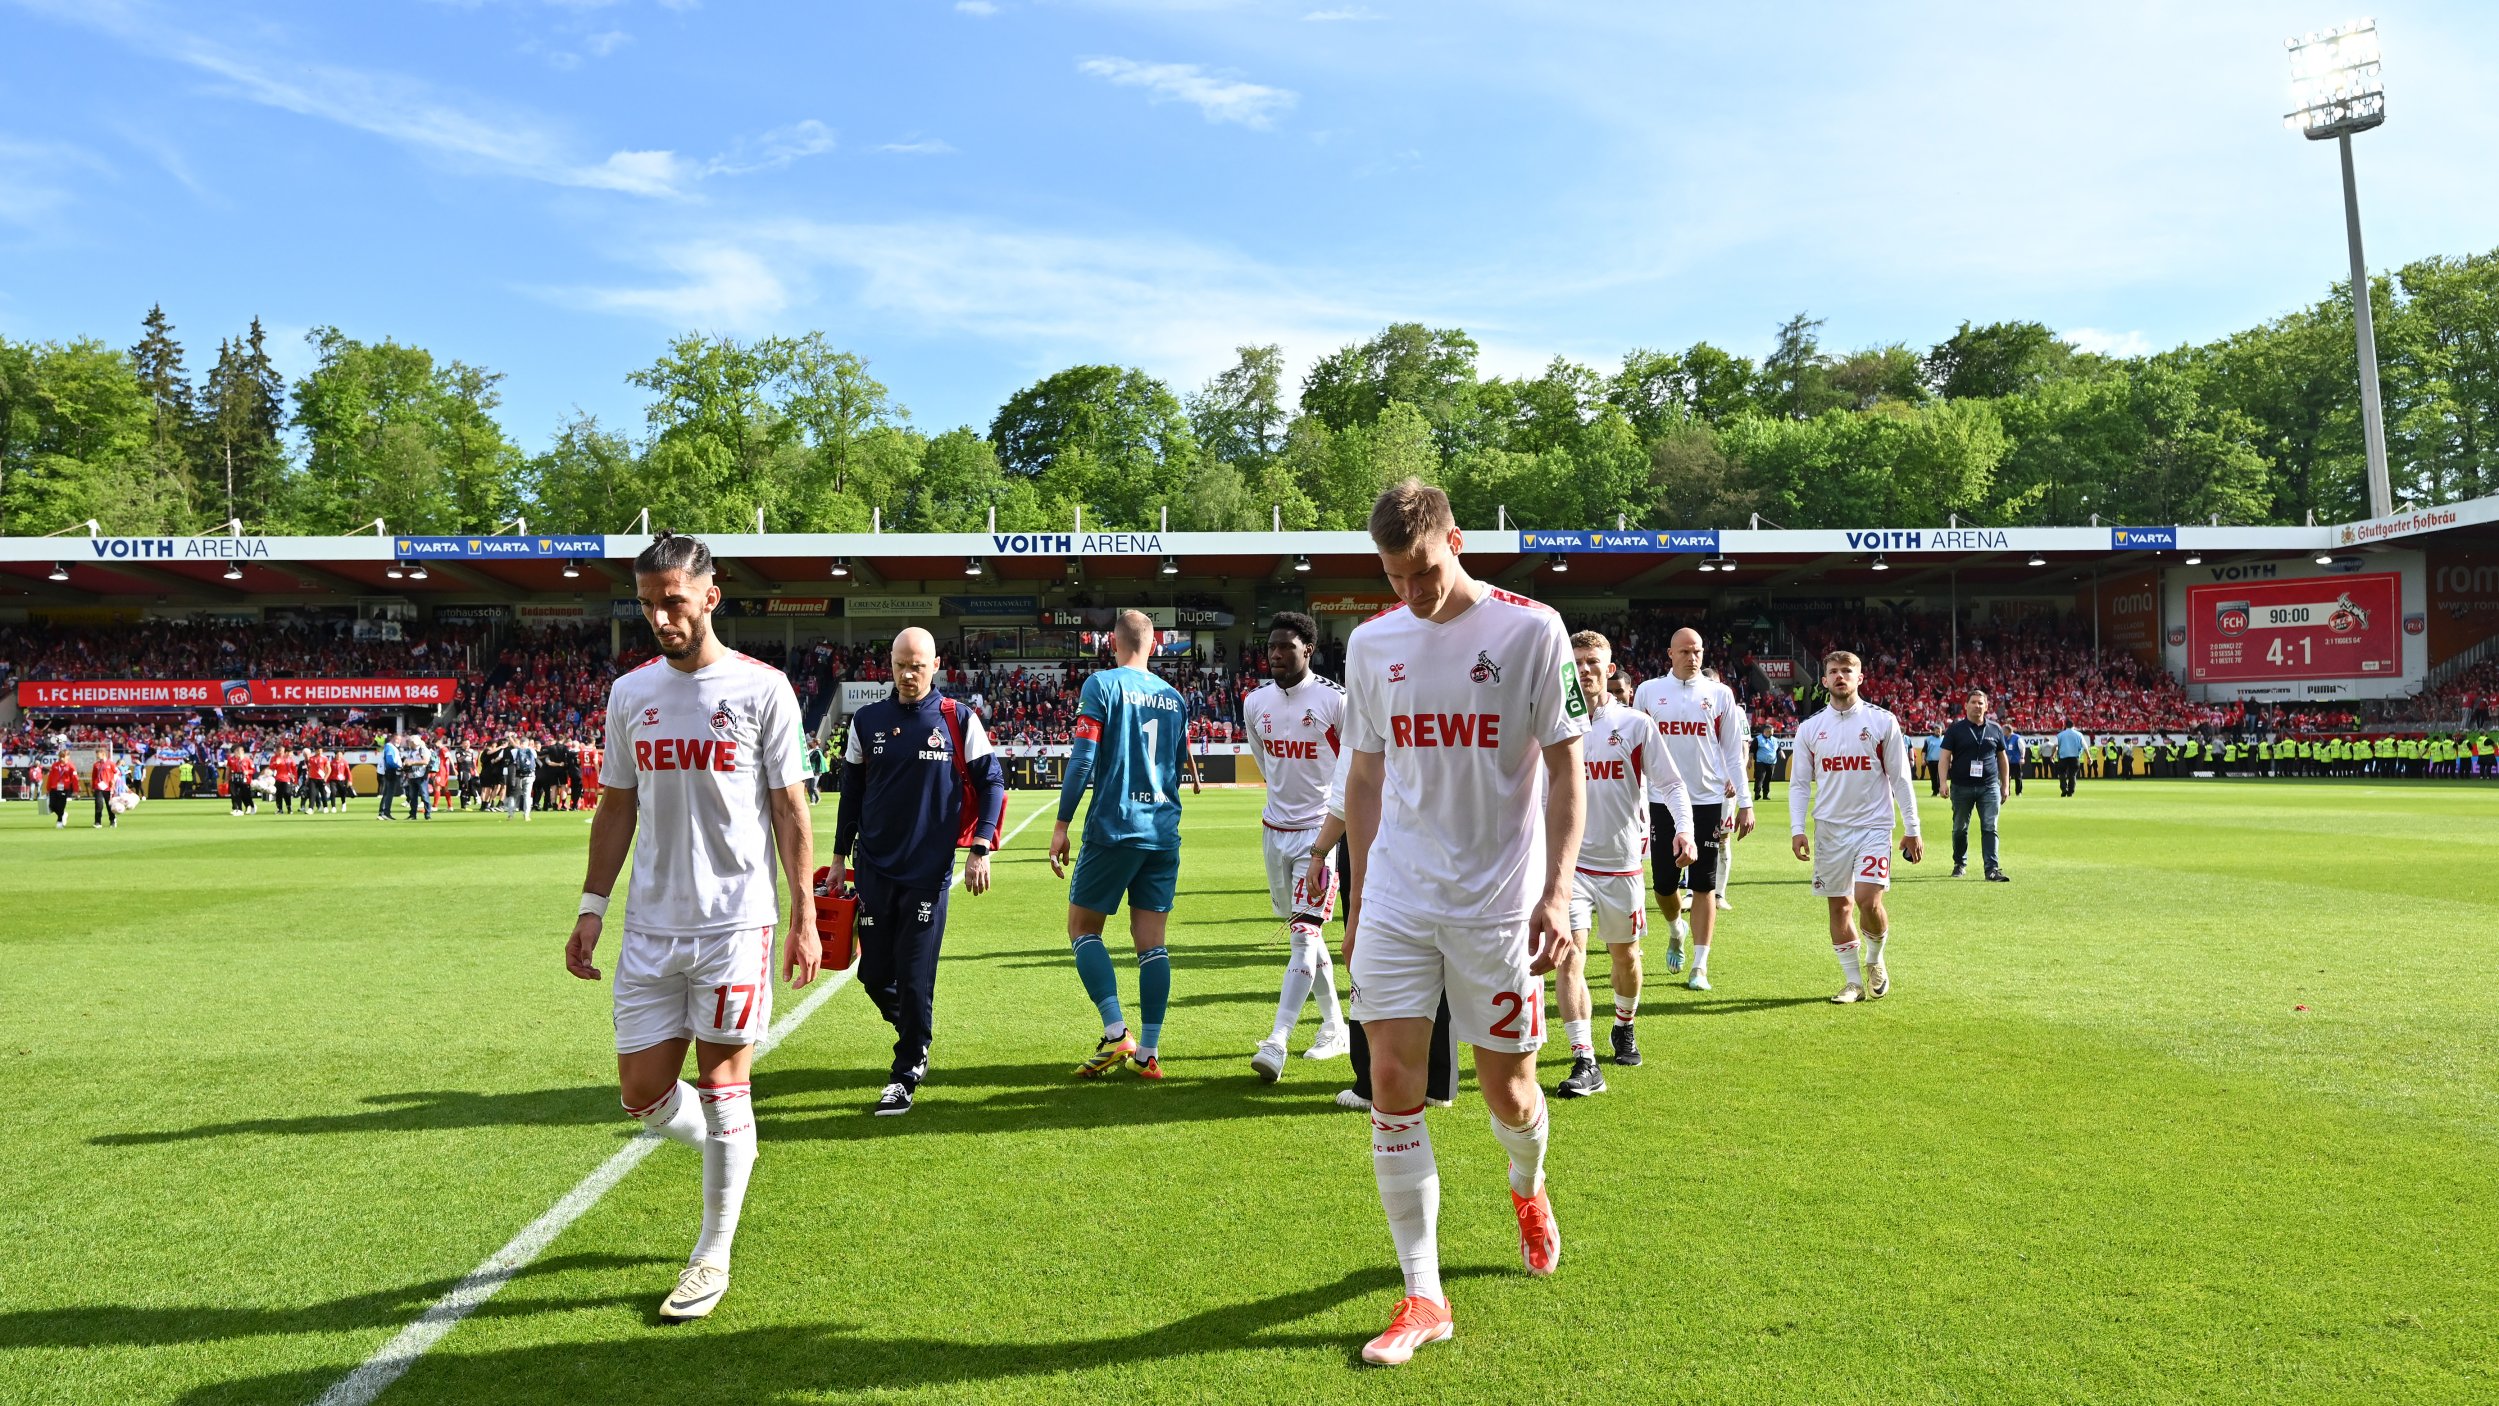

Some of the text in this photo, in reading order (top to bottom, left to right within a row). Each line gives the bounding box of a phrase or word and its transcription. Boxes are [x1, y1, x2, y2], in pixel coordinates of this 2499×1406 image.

[2357, 510, 2456, 540] Stuttgarter Hofbräu
[992, 534, 1162, 553] VOITH ARENA
[1538, 536, 1582, 546] VARTA
[1605, 536, 1649, 546] VARTA
[1671, 536, 1715, 546] VARTA
[1846, 531, 2008, 549] VOITH ARENA
[2129, 534, 2172, 543] VARTA
[91, 539, 269, 557] VOITH ARENA
[413, 542, 460, 552] VARTA
[483, 542, 530, 552] VARTA
[554, 541, 600, 551] VARTA
[2210, 563, 2277, 581] VOITH
[2436, 565, 2499, 593] rom
[612, 601, 634, 616] Auch
[767, 599, 829, 612] Hummel
[1311, 601, 1379, 611] GRÖTZINGER
[2112, 591, 2152, 616] roma
[1054, 611, 1082, 625] liha
[1178, 608, 1219, 623] huper
[2223, 616, 2244, 629] FCH
[2269, 607, 2310, 624] 90:00
[2266, 636, 2312, 666] 4:1
[1759, 662, 1790, 672] REWE
[37, 687, 208, 701] 1. FC HEIDENHEIM 1846
[270, 685, 439, 699] 1. FC HEIDENHEIM 1846
[861, 689, 887, 698] MHP
[1564, 668, 1583, 714] DEVK
[2307, 685, 2337, 694] PUMA
[230, 692, 248, 705] FCH
[1123, 690, 1179, 713] SCHWÄBE
[1263, 724, 1272, 734] 18
[1390, 713, 1500, 748] REWE
[1659, 721, 1707, 737] REWE
[635, 738, 737, 772] REWE
[873, 746, 884, 755] CO
[918, 750, 950, 761] REWE
[1263, 739, 1318, 760] REWE
[583, 751, 590, 763] 5
[1822, 755, 1872, 773] REWE
[1181, 772, 1205, 782] mt
[1584, 760, 1625, 780] EWE
[1139, 792, 1151, 802] FC
[1860, 855, 1889, 879] 29
[918, 913, 930, 923] CO
[713, 983, 756, 1030] 17
[1489, 988, 1539, 1039] 21
[722, 1122, 751, 1136] KÖLN
[1386, 1139, 1421, 1153] KÖLN
